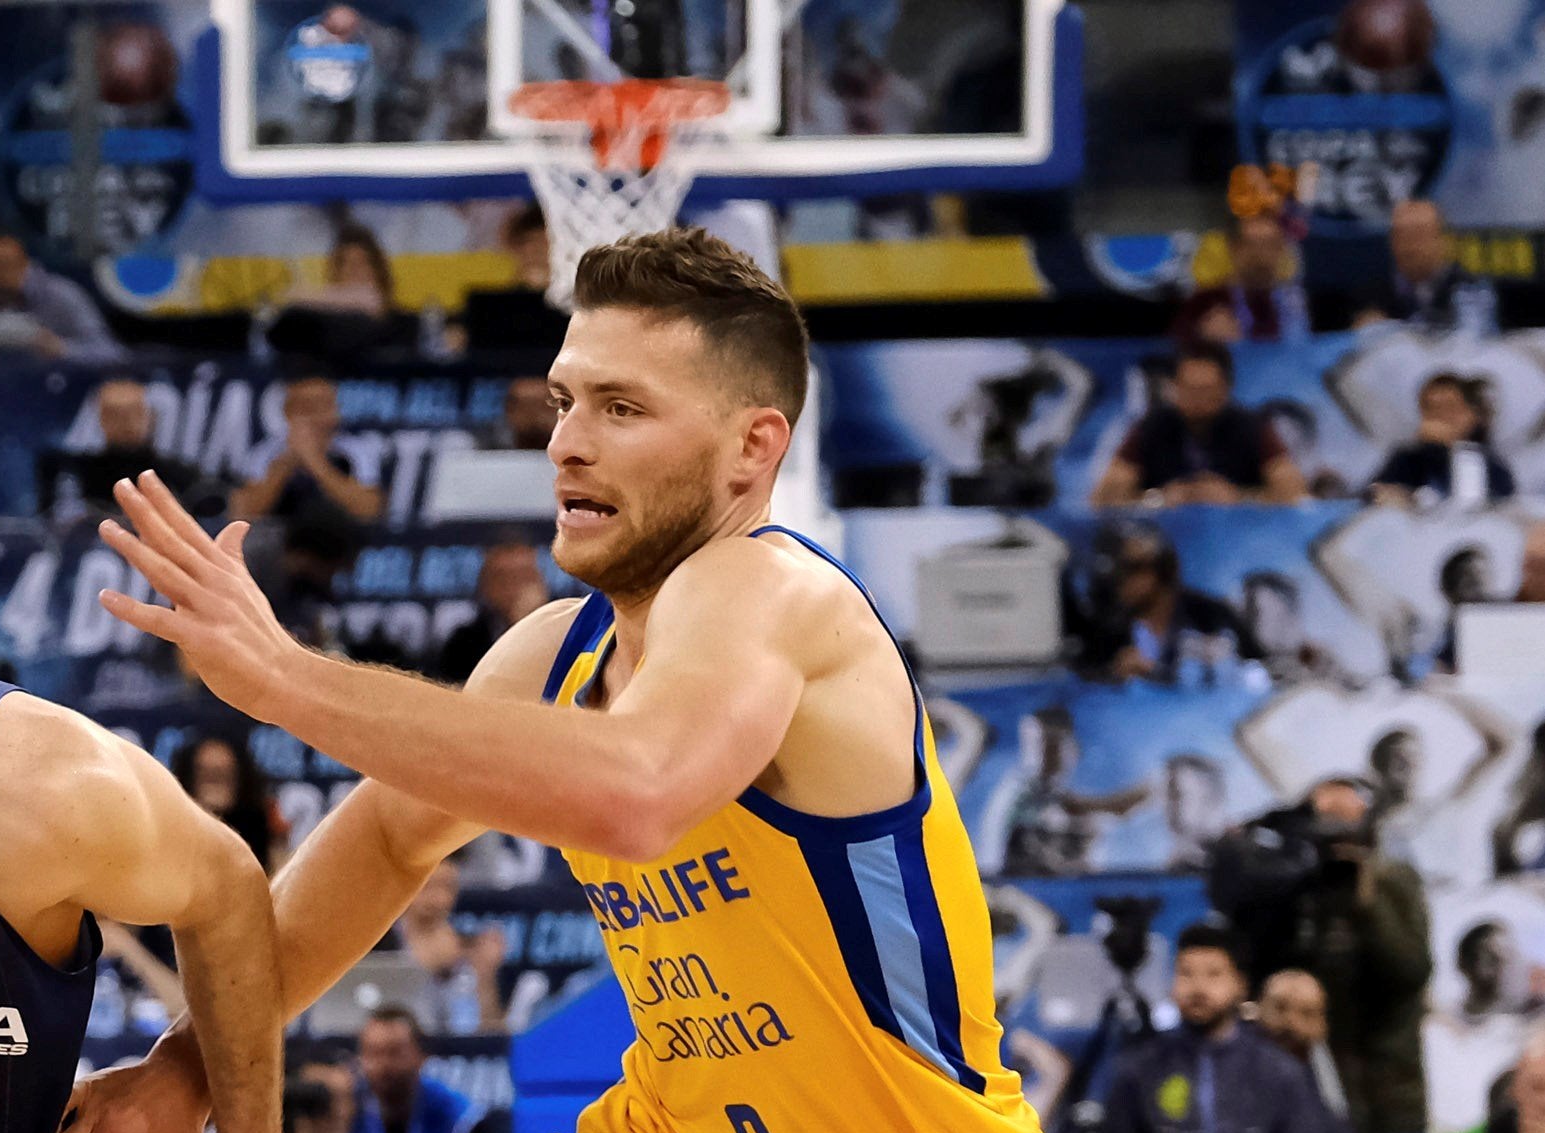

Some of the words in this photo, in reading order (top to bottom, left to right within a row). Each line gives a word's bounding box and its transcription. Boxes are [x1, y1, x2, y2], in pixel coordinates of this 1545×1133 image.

[583, 847, 750, 932] RBALIFE
[618, 943, 720, 1006] Gran
[633, 991, 795, 1062] Canaria
